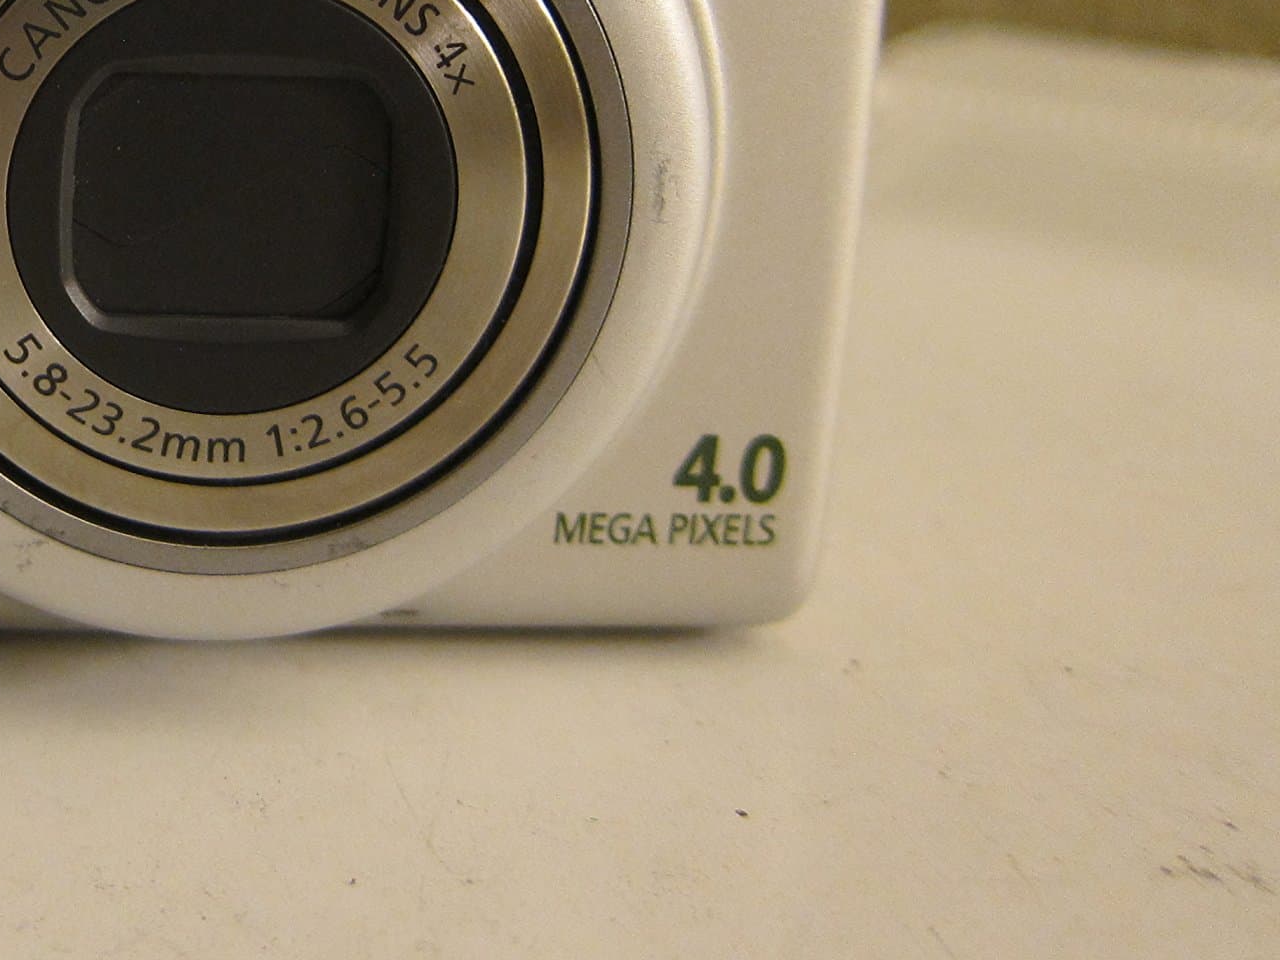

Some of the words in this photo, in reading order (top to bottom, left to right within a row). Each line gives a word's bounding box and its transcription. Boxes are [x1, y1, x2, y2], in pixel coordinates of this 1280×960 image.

[3, 333, 247, 463] 5.8-23.2mm
[265, 343, 439, 458] 1:2.6-5.5
[673, 433, 787, 503] 4.0
[553, 512, 657, 545] MEGA
[668, 513, 776, 545] PIXELS
